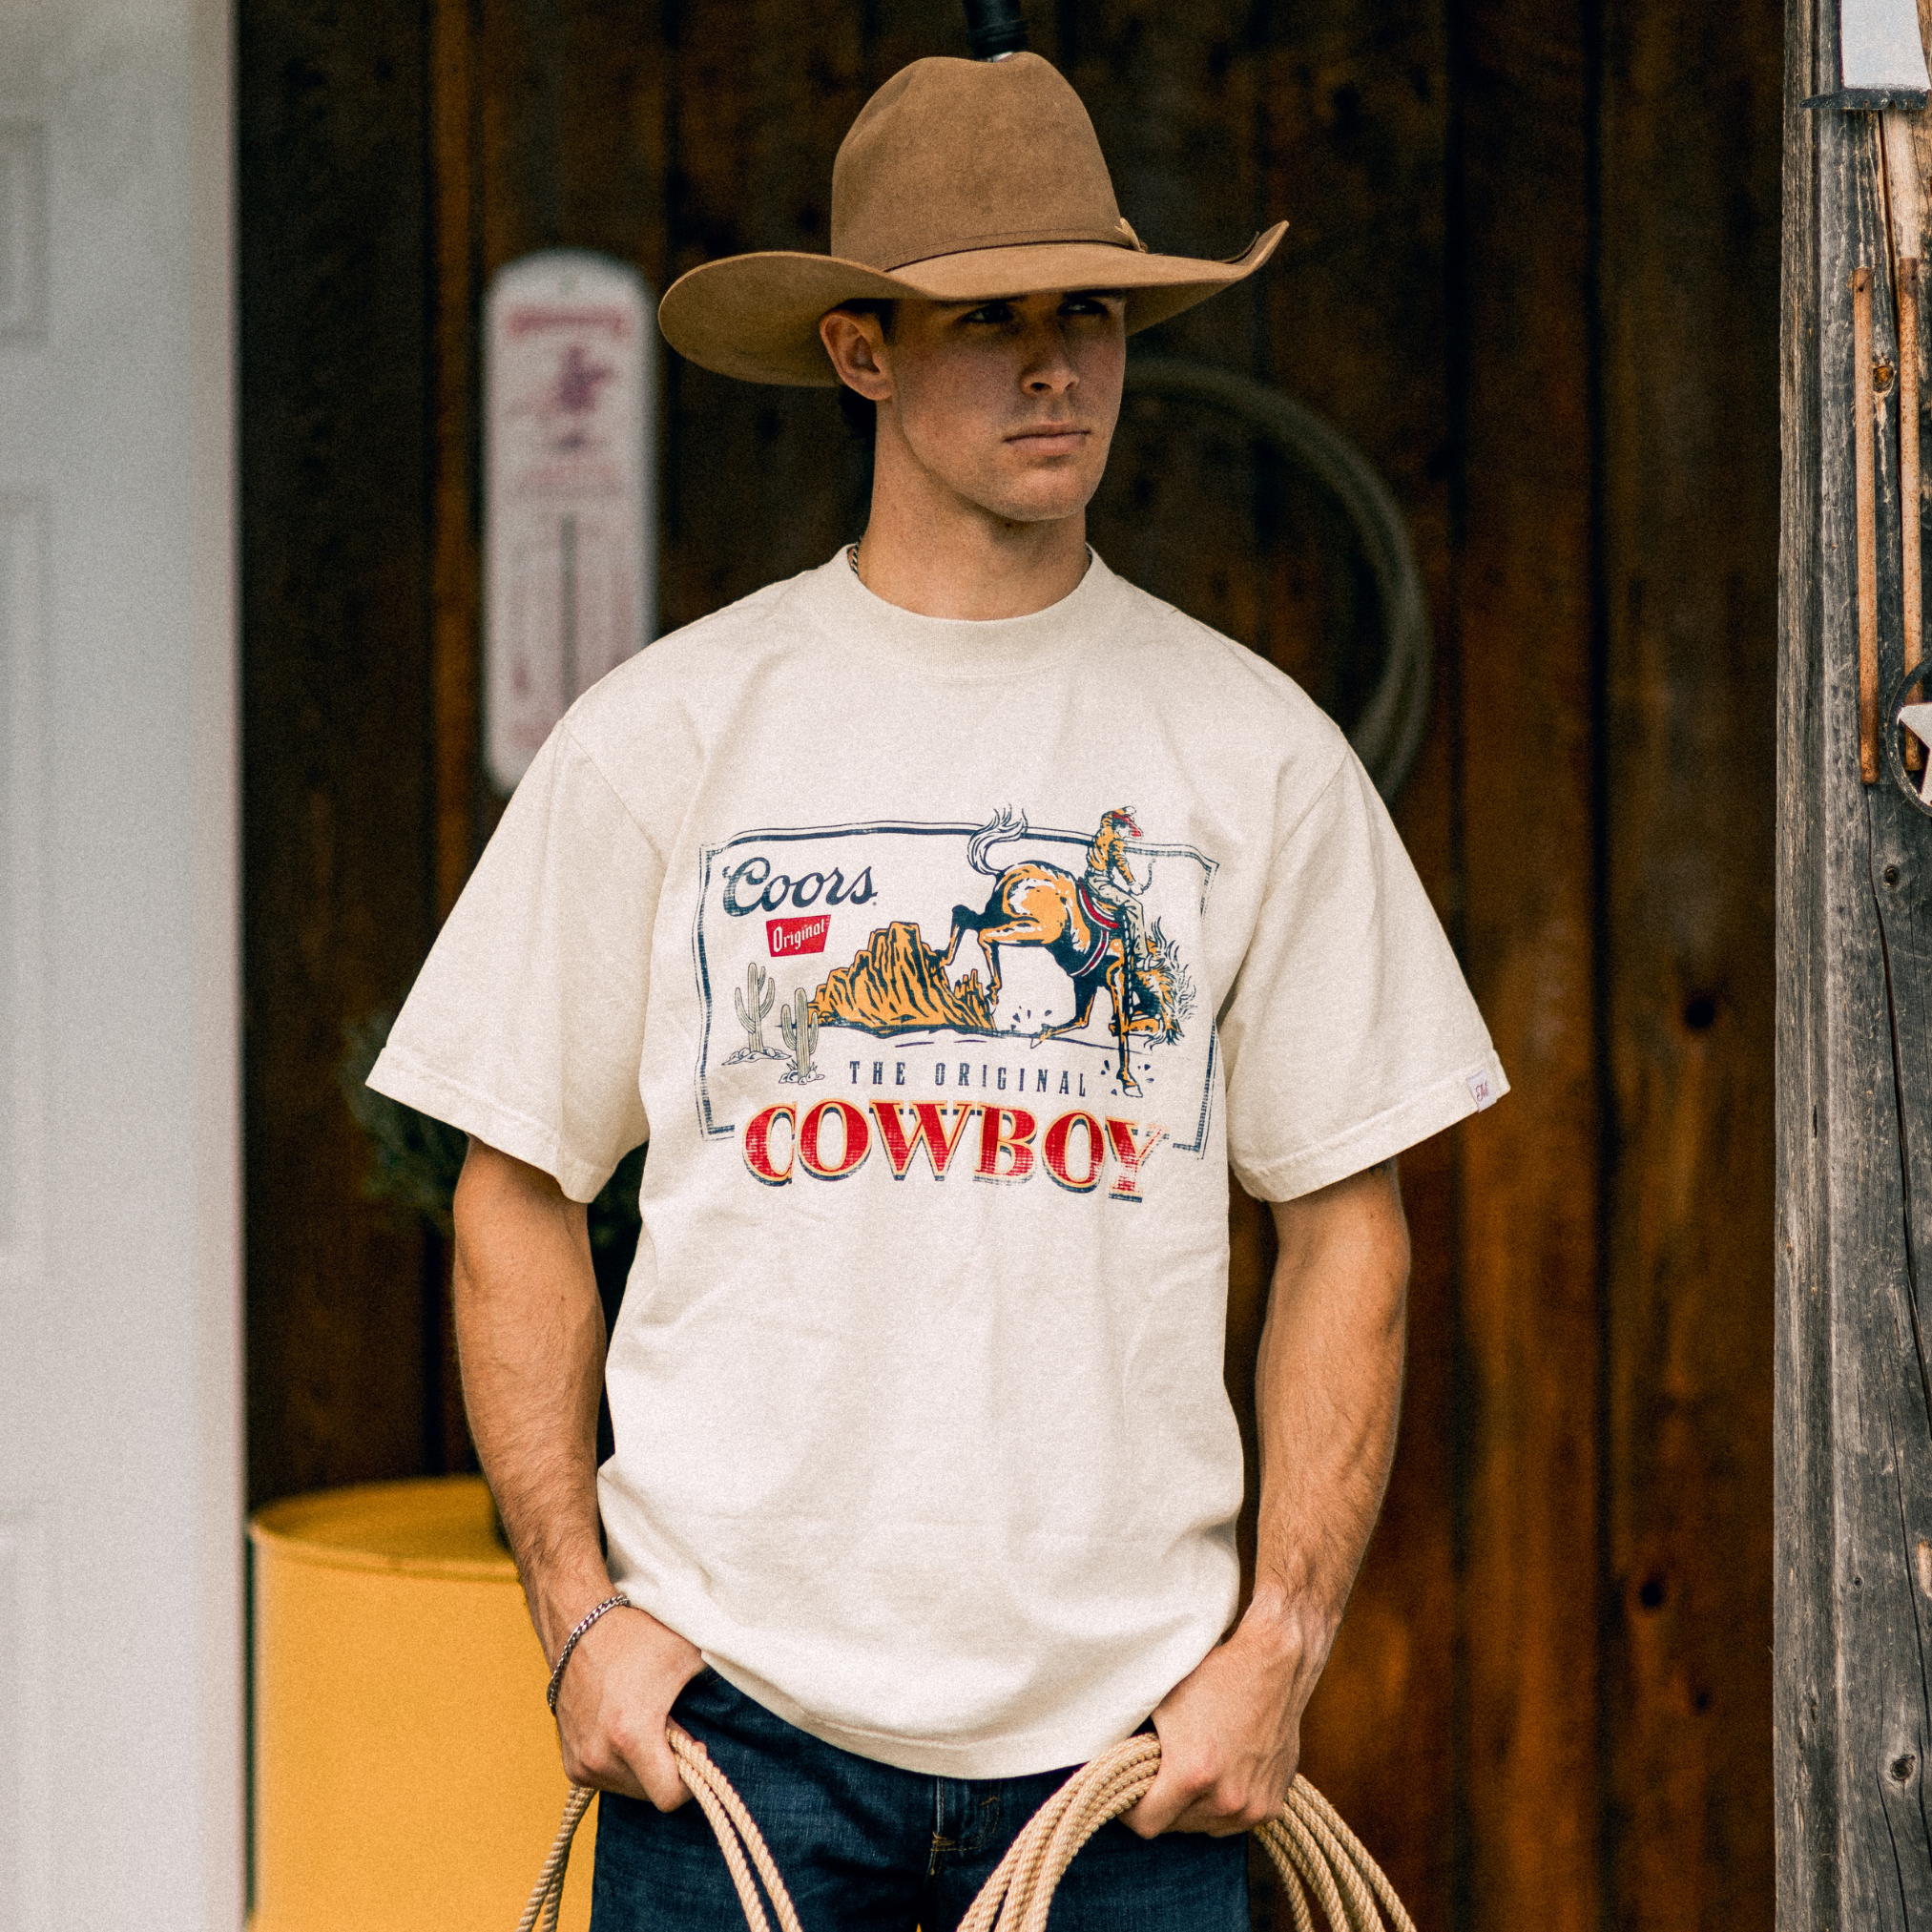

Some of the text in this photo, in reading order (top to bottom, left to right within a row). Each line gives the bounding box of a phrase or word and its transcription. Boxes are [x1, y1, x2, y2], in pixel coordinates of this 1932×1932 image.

[722, 857, 878, 917] Coors
[773, 919, 825, 953] Original
[849, 1060, 1087, 1097] THE ORIGINAL
[741, 1098, 1170, 1203] COWBOY
